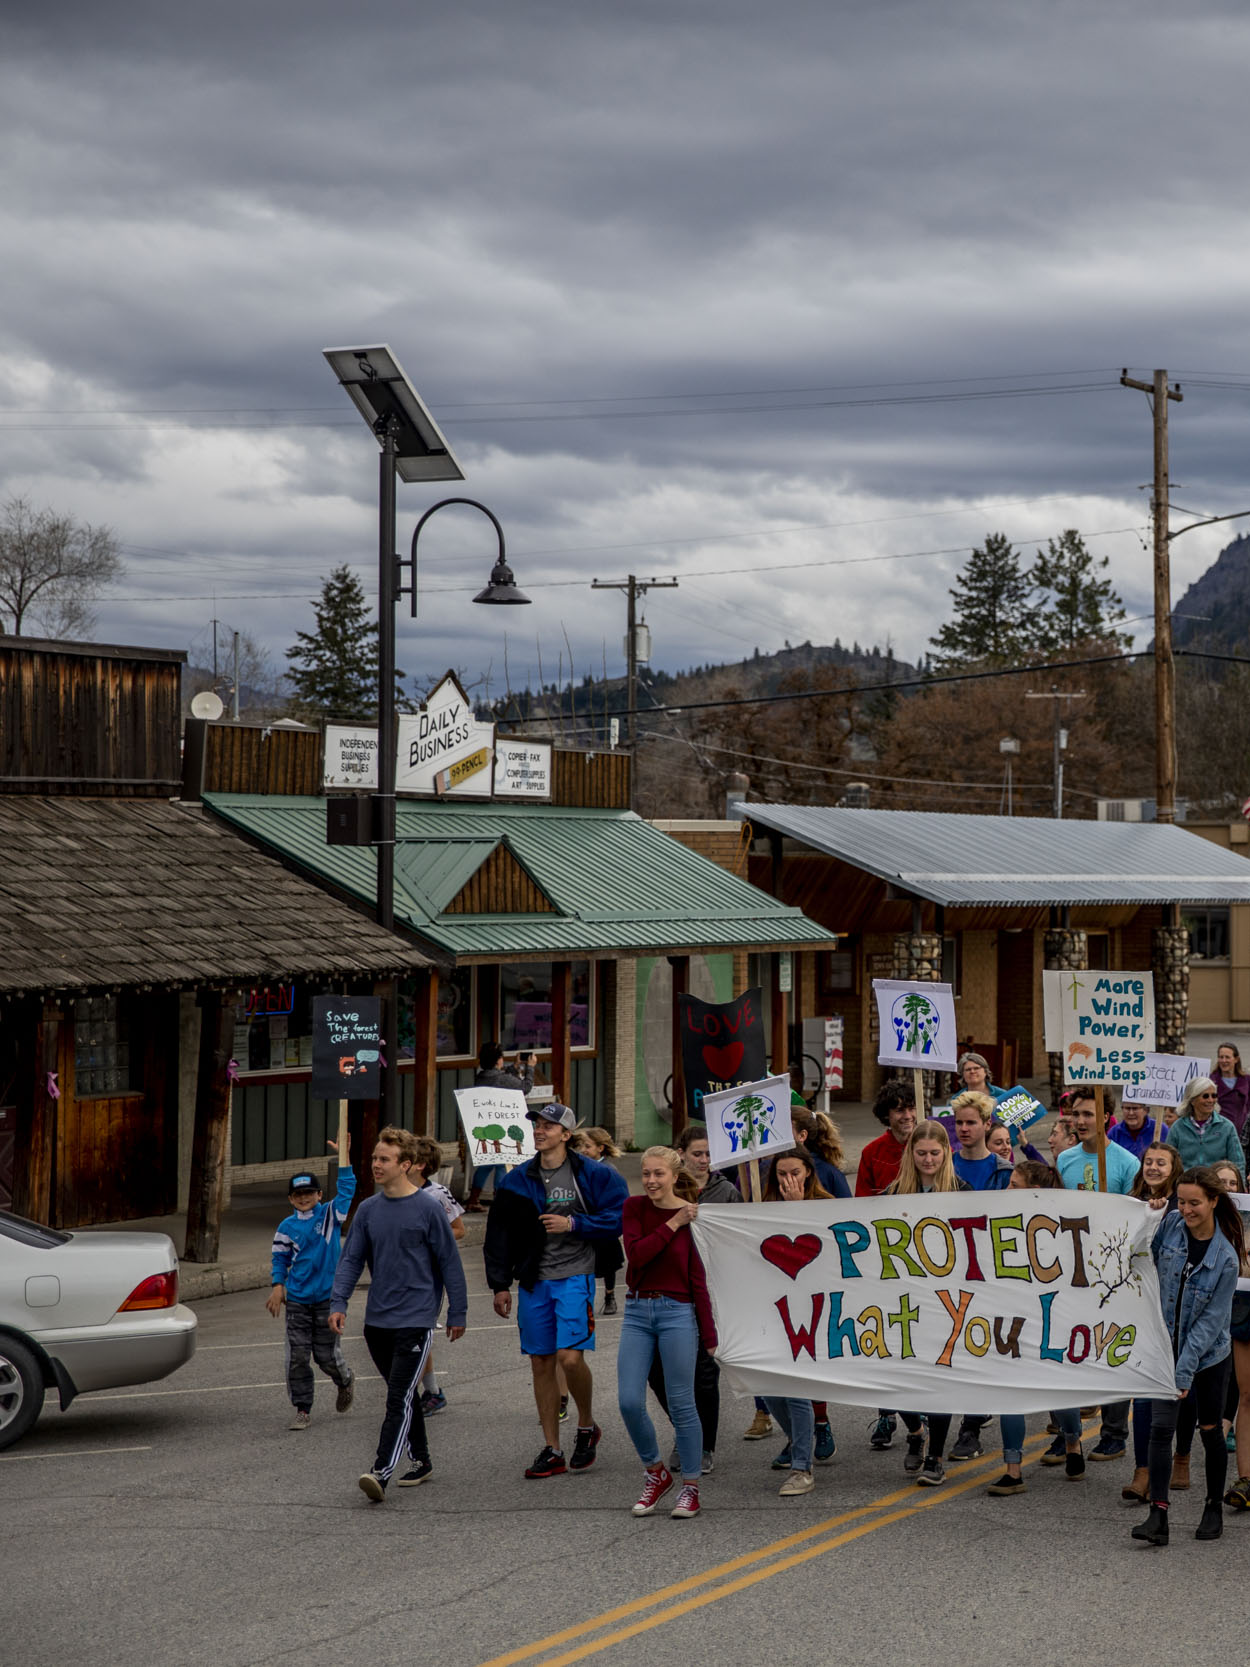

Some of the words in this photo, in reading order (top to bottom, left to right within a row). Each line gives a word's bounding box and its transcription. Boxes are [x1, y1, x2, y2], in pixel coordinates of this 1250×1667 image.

[419, 704, 460, 740] DAILY
[340, 738, 378, 749] INDEPENDEN
[409, 722, 469, 768] BUSINESS
[341, 751, 371, 761] BUSINESS
[511, 781, 522, 789] ART
[1094, 978, 1145, 996] More
[326, 1010, 360, 1022] Save
[1091, 996, 1144, 1018] Wind
[687, 999, 756, 1036] LOVE
[327, 1022, 348, 1033] The
[353, 1022, 378, 1032] forest
[1078, 1016, 1145, 1041] Power,
[330, 1033, 380, 1044] CREATURES
[1095, 1048, 1146, 1063] Less
[1067, 1064, 1146, 1086] Wind-Bags
[996, 1093, 1025, 1113] 100%
[1003, 1099, 1029, 1119] CLEAN
[477, 1111, 484, 1119] A
[487, 1111, 521, 1120] FOREST
[1023, 1110, 1036, 1122] WA
[828, 1213, 1091, 1288] PROTECT
[773, 1291, 920, 1362] What
[934, 1288, 1027, 1368] You
[1038, 1290, 1138, 1368] Love
